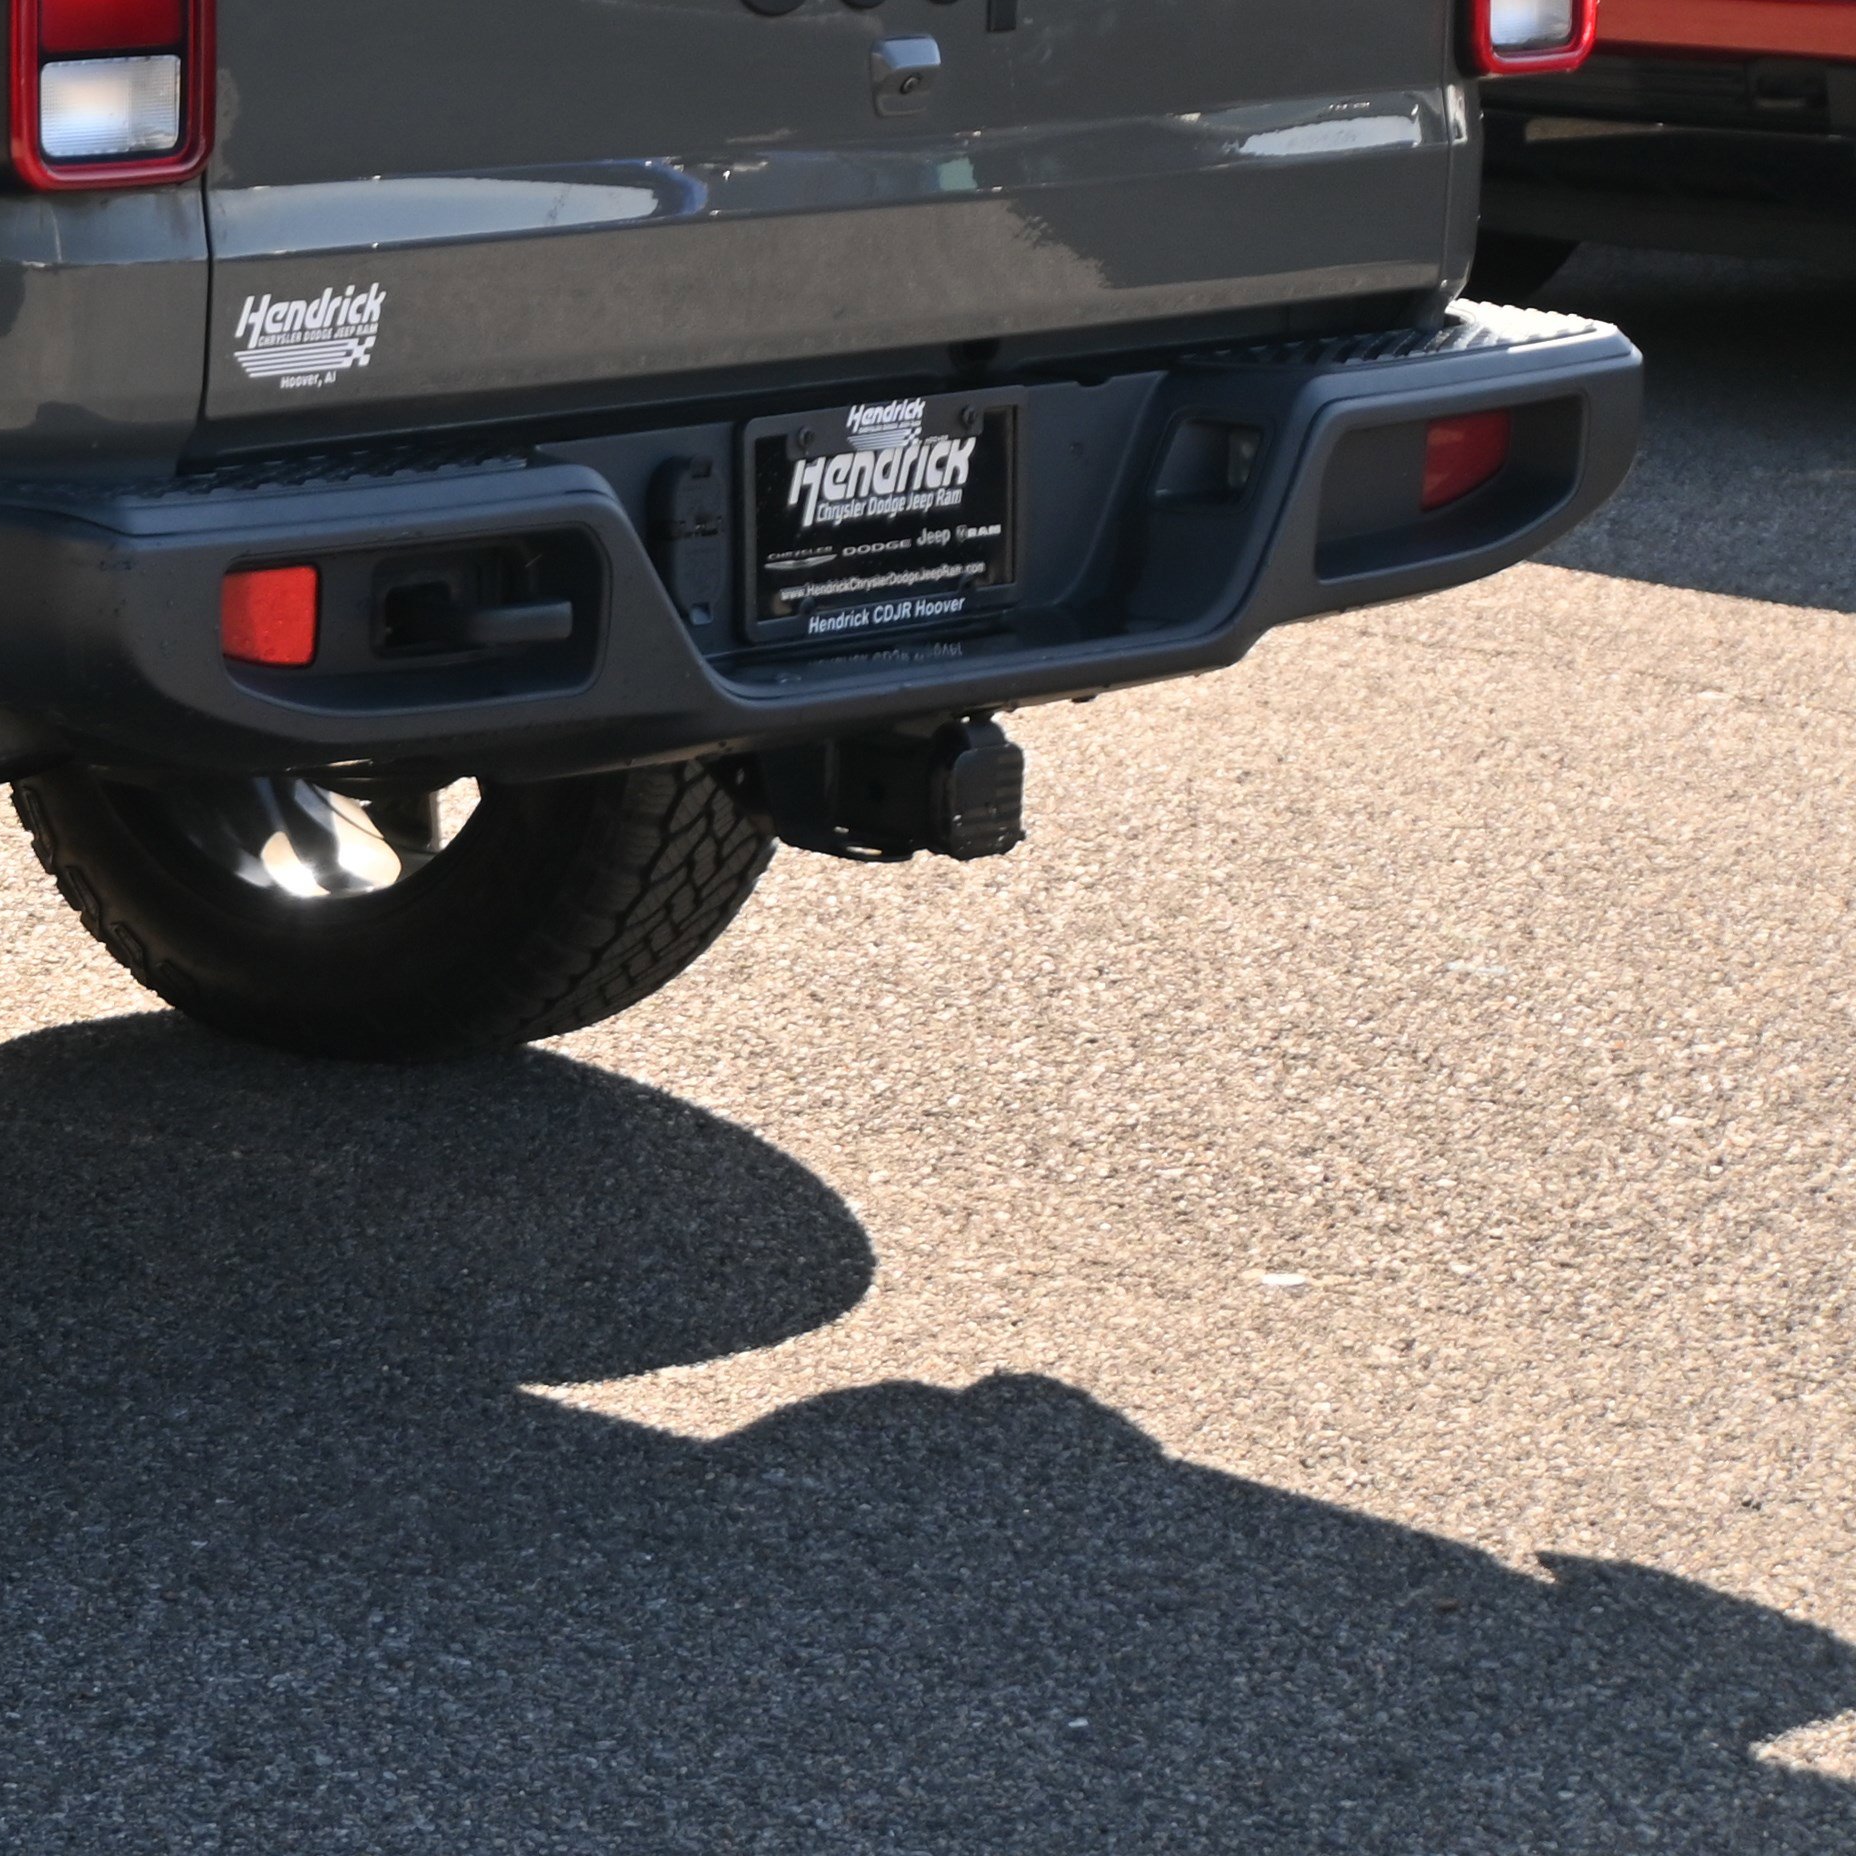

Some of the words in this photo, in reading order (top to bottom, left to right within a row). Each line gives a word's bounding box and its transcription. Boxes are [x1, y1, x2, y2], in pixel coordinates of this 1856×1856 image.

[234, 282, 387, 350] Hendrick
[258, 330, 302, 347] CHRYSLER
[302, 327, 333, 343] DODGE
[333, 325, 355, 339] JEEP
[356, 322, 379, 336] RAM
[280, 373, 323, 389] Hoover,
[846, 397, 926, 433] Hendrick
[788, 436, 977, 528] Hendrick
[816, 498, 867, 525] Chrysler
[867, 494, 906, 517] Dodge
[905, 491, 934, 512] Jeep
[935, 488, 962, 506] Ram
[767, 545, 834, 561] CHRYSLER
[842, 539, 912, 557] DODGE
[917, 527, 951, 547] Jeep
[967, 524, 1002, 538] RAM
[808, 607, 870, 634] Hendrick
[873, 600, 912, 624] CDJR
[915, 596, 966, 617] Hoover
